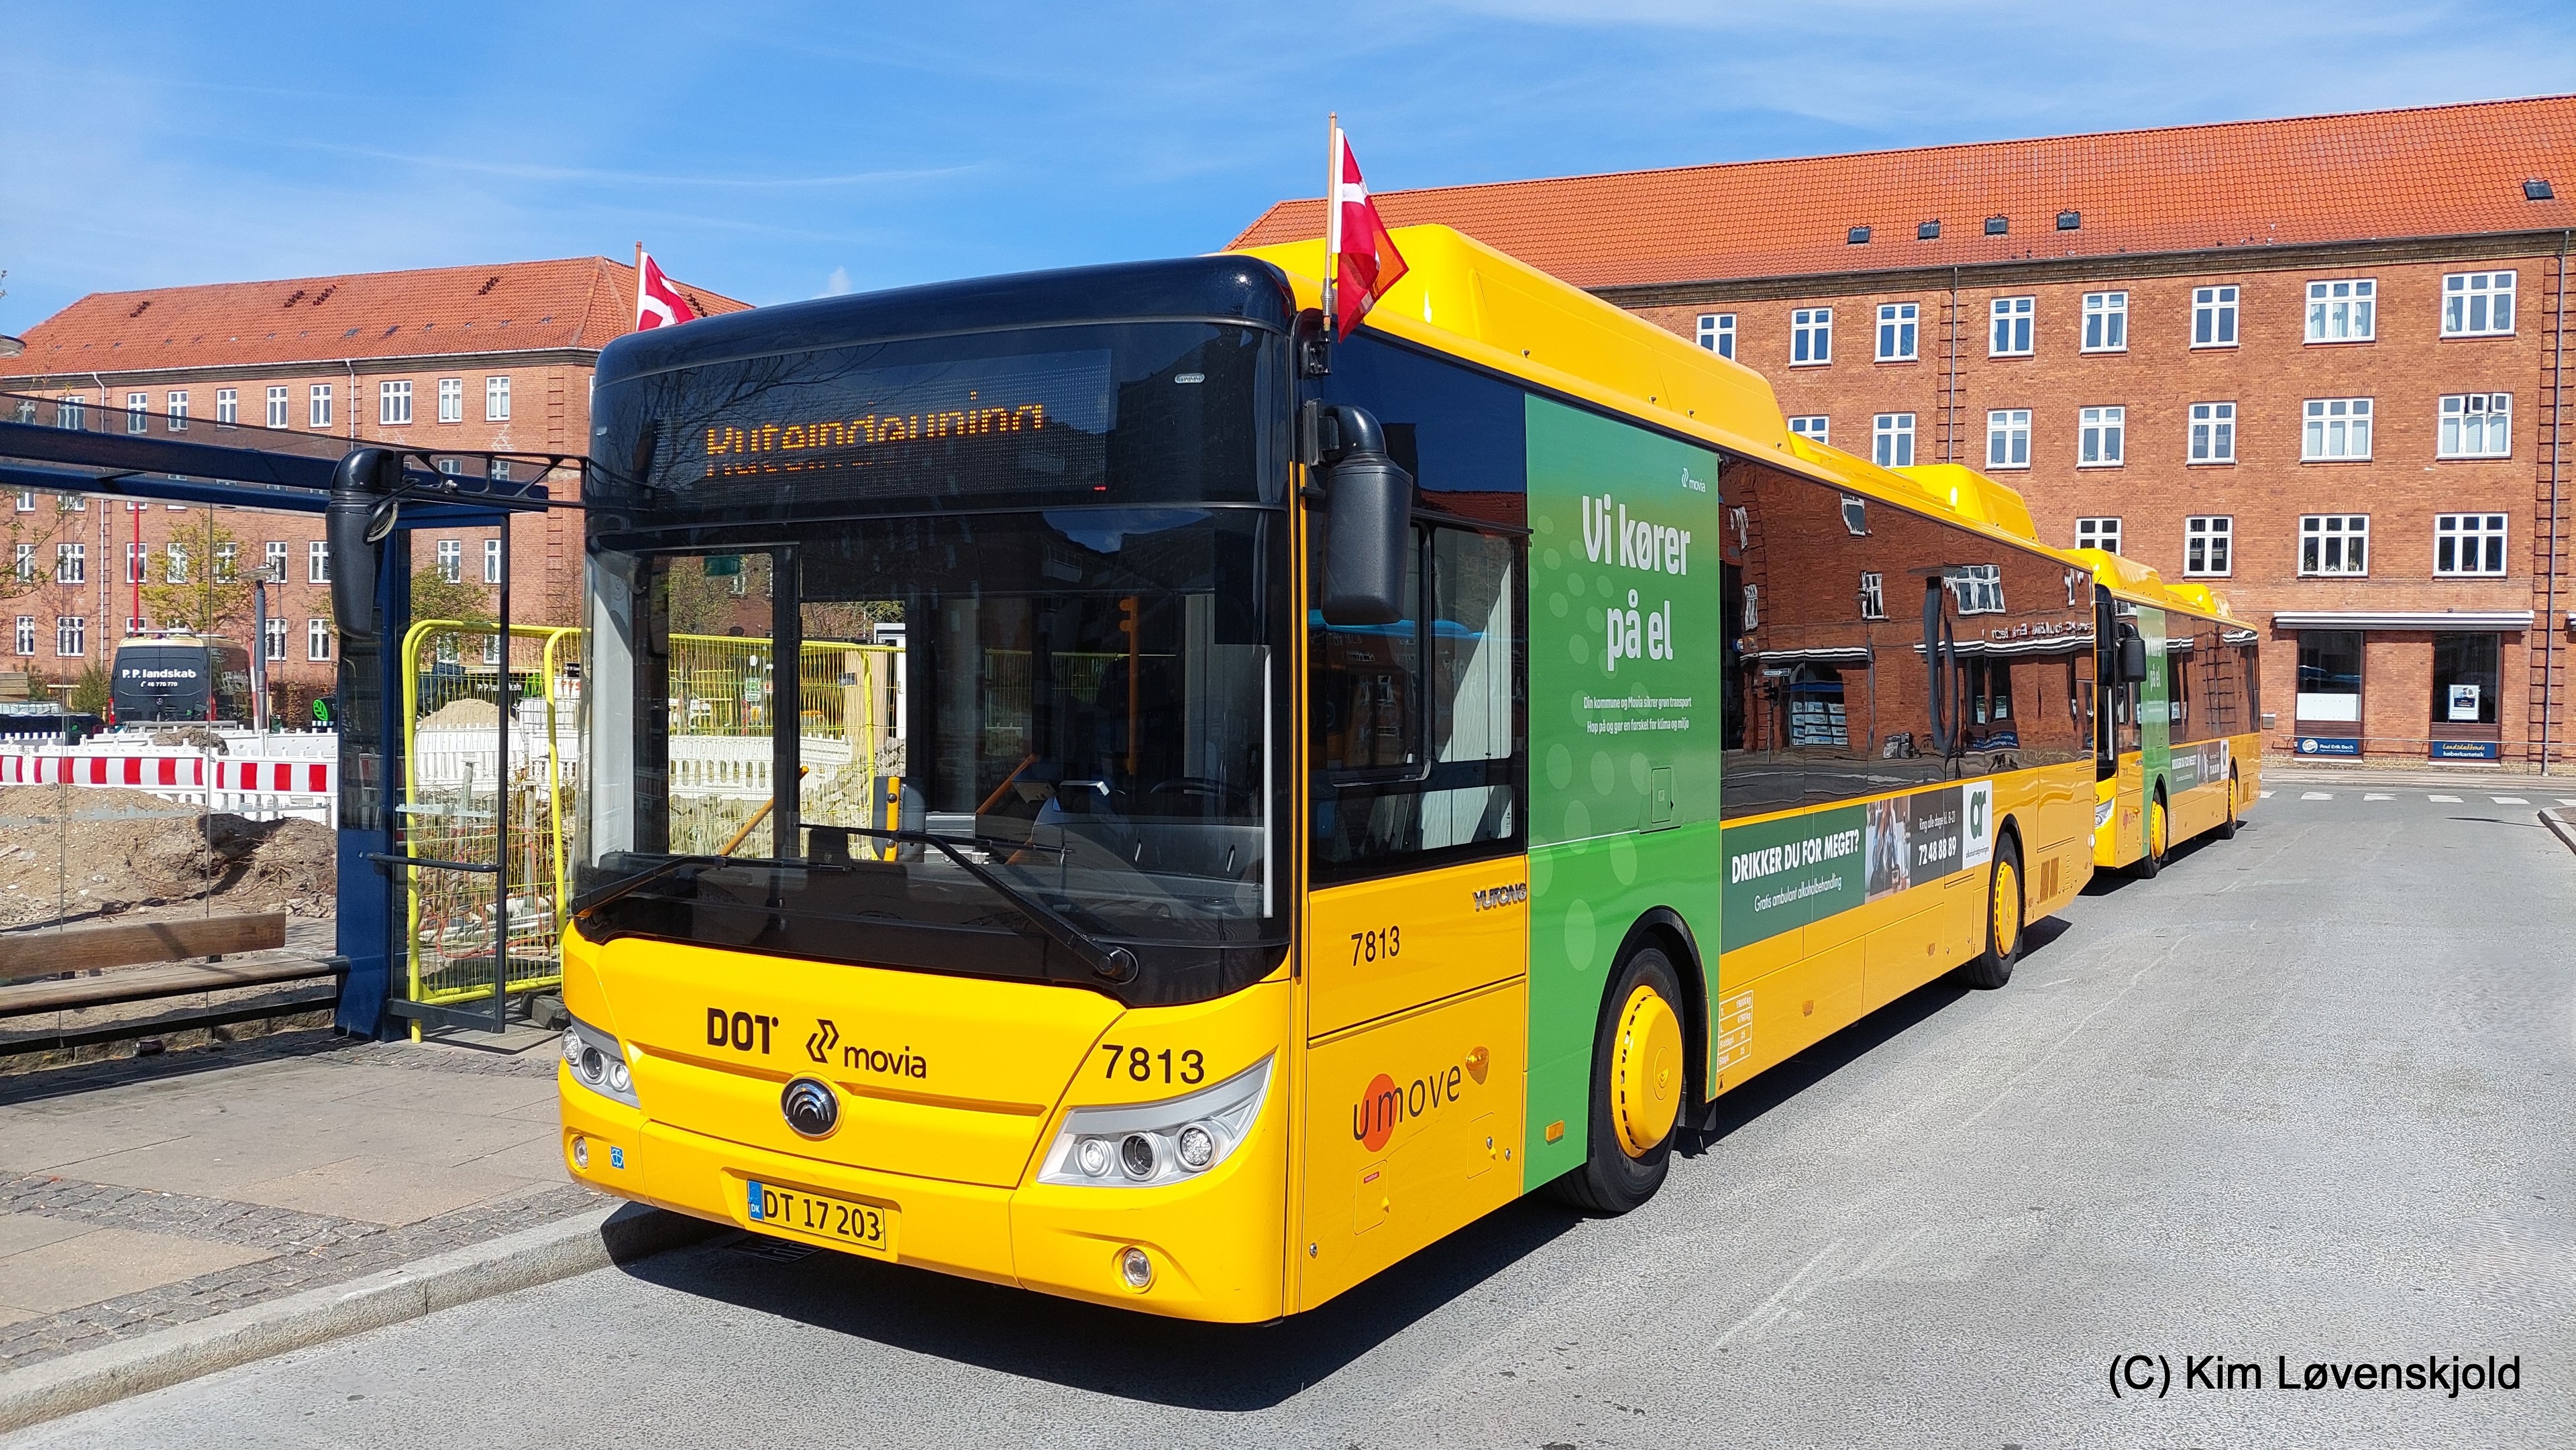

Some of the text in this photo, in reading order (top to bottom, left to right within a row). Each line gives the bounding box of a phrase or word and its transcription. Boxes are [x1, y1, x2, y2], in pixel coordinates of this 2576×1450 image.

[1689, 478, 1706, 492] movia
[1582, 494, 1690, 575] Vi kører
[1607, 589, 1673, 671] på el
[143, 669, 197, 678] landskab
[1583, 695, 1593, 709] Din
[1594, 697, 1620, 709] kommune
[1621, 700, 1627, 710] og
[1628, 695, 1643, 708] Movia
[1644, 695, 1658, 708] sikrer
[1670, 697, 1691, 709] transport
[1587, 720, 1598, 735] Hop
[1599, 719, 1605, 734] på
[1607, 722, 1613, 734] og
[1623, 722, 1630, 731] en
[1631, 719, 1649, 730] forskel
[1658, 718, 1670, 729] klima
[1671, 720, 1677, 731] og
[1919, 818, 1927, 833] Ring
[1935, 813, 1943, 830] dage
[1948, 810, 1956, 824] 8-21
[1732, 828, 1860, 884] DRIKKER DU FOR MEGET?
[1919, 836, 1957, 866] 72 48 88 89
[1472, 883, 1527, 909] YUTONG
[1754, 872, 1842, 912] Gratis ambulant alkoholbehandling
[1350, 925, 1400, 966] 7813
[707, 1007, 779, 1055] DOT
[844, 1045, 926, 1079] movia
[1102, 1044, 1204, 1084] 7813
[751, 1203, 760, 1213] DK
[763, 1190, 880, 1241] DT 17 203
